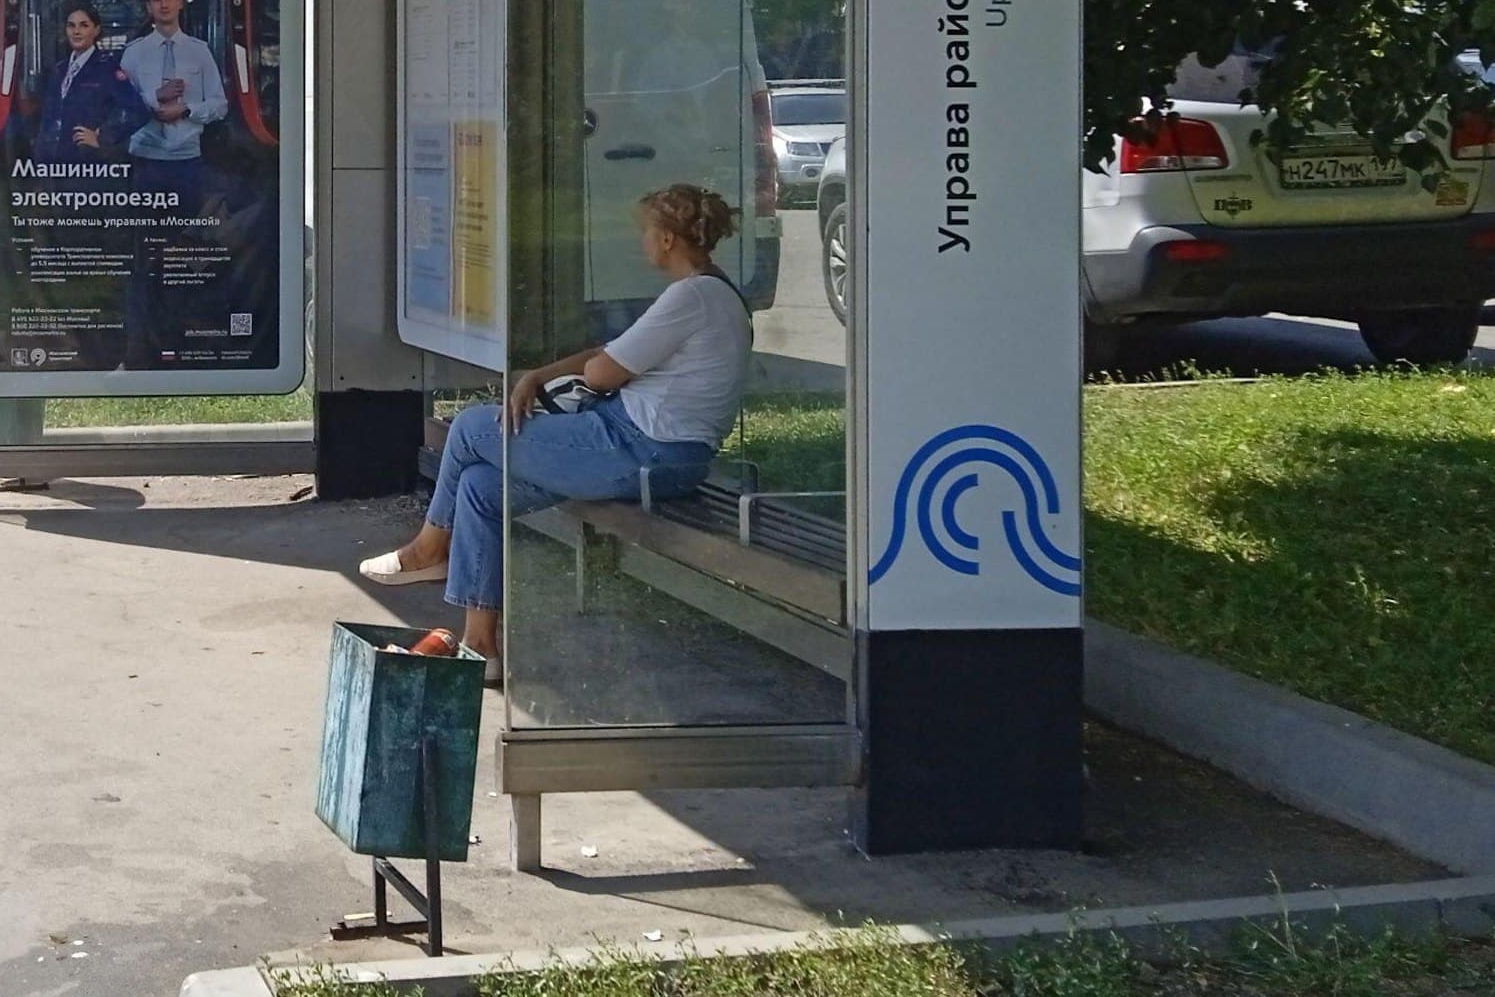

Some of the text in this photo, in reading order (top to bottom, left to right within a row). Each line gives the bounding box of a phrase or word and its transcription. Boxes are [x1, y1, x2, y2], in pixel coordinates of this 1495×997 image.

[11, 158, 131, 178] Машинист
[937, 103, 977, 253] Управа
[11, 191, 180, 210] электропоезда
[11, 215, 221, 229] Ты тоже можешь управлять «Москвой»
